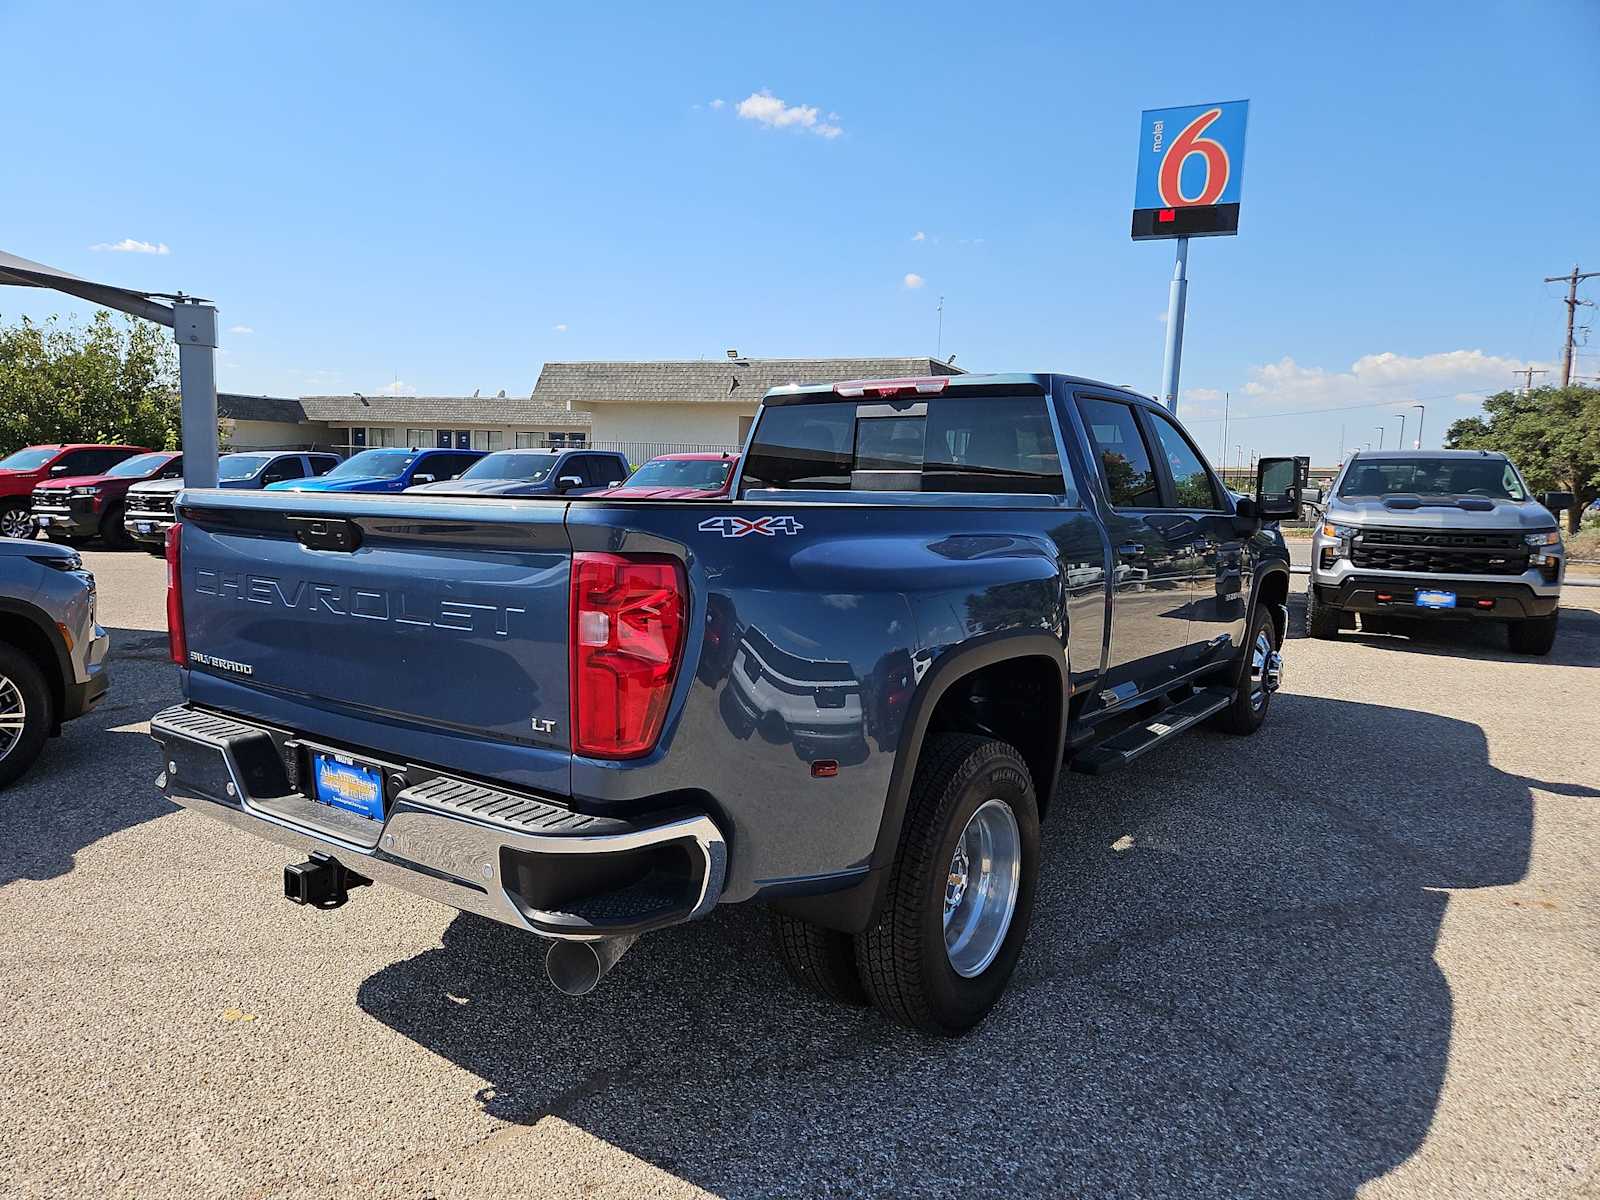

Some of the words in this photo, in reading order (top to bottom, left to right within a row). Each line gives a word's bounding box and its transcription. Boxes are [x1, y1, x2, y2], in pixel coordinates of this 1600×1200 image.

[1152, 120, 1164, 153] motel
[1158, 108, 1231, 208] 6
[194, 567, 526, 636] CHEVROLET
[189, 651, 253, 675] SILVERADO
[531, 717, 556, 733] LT
